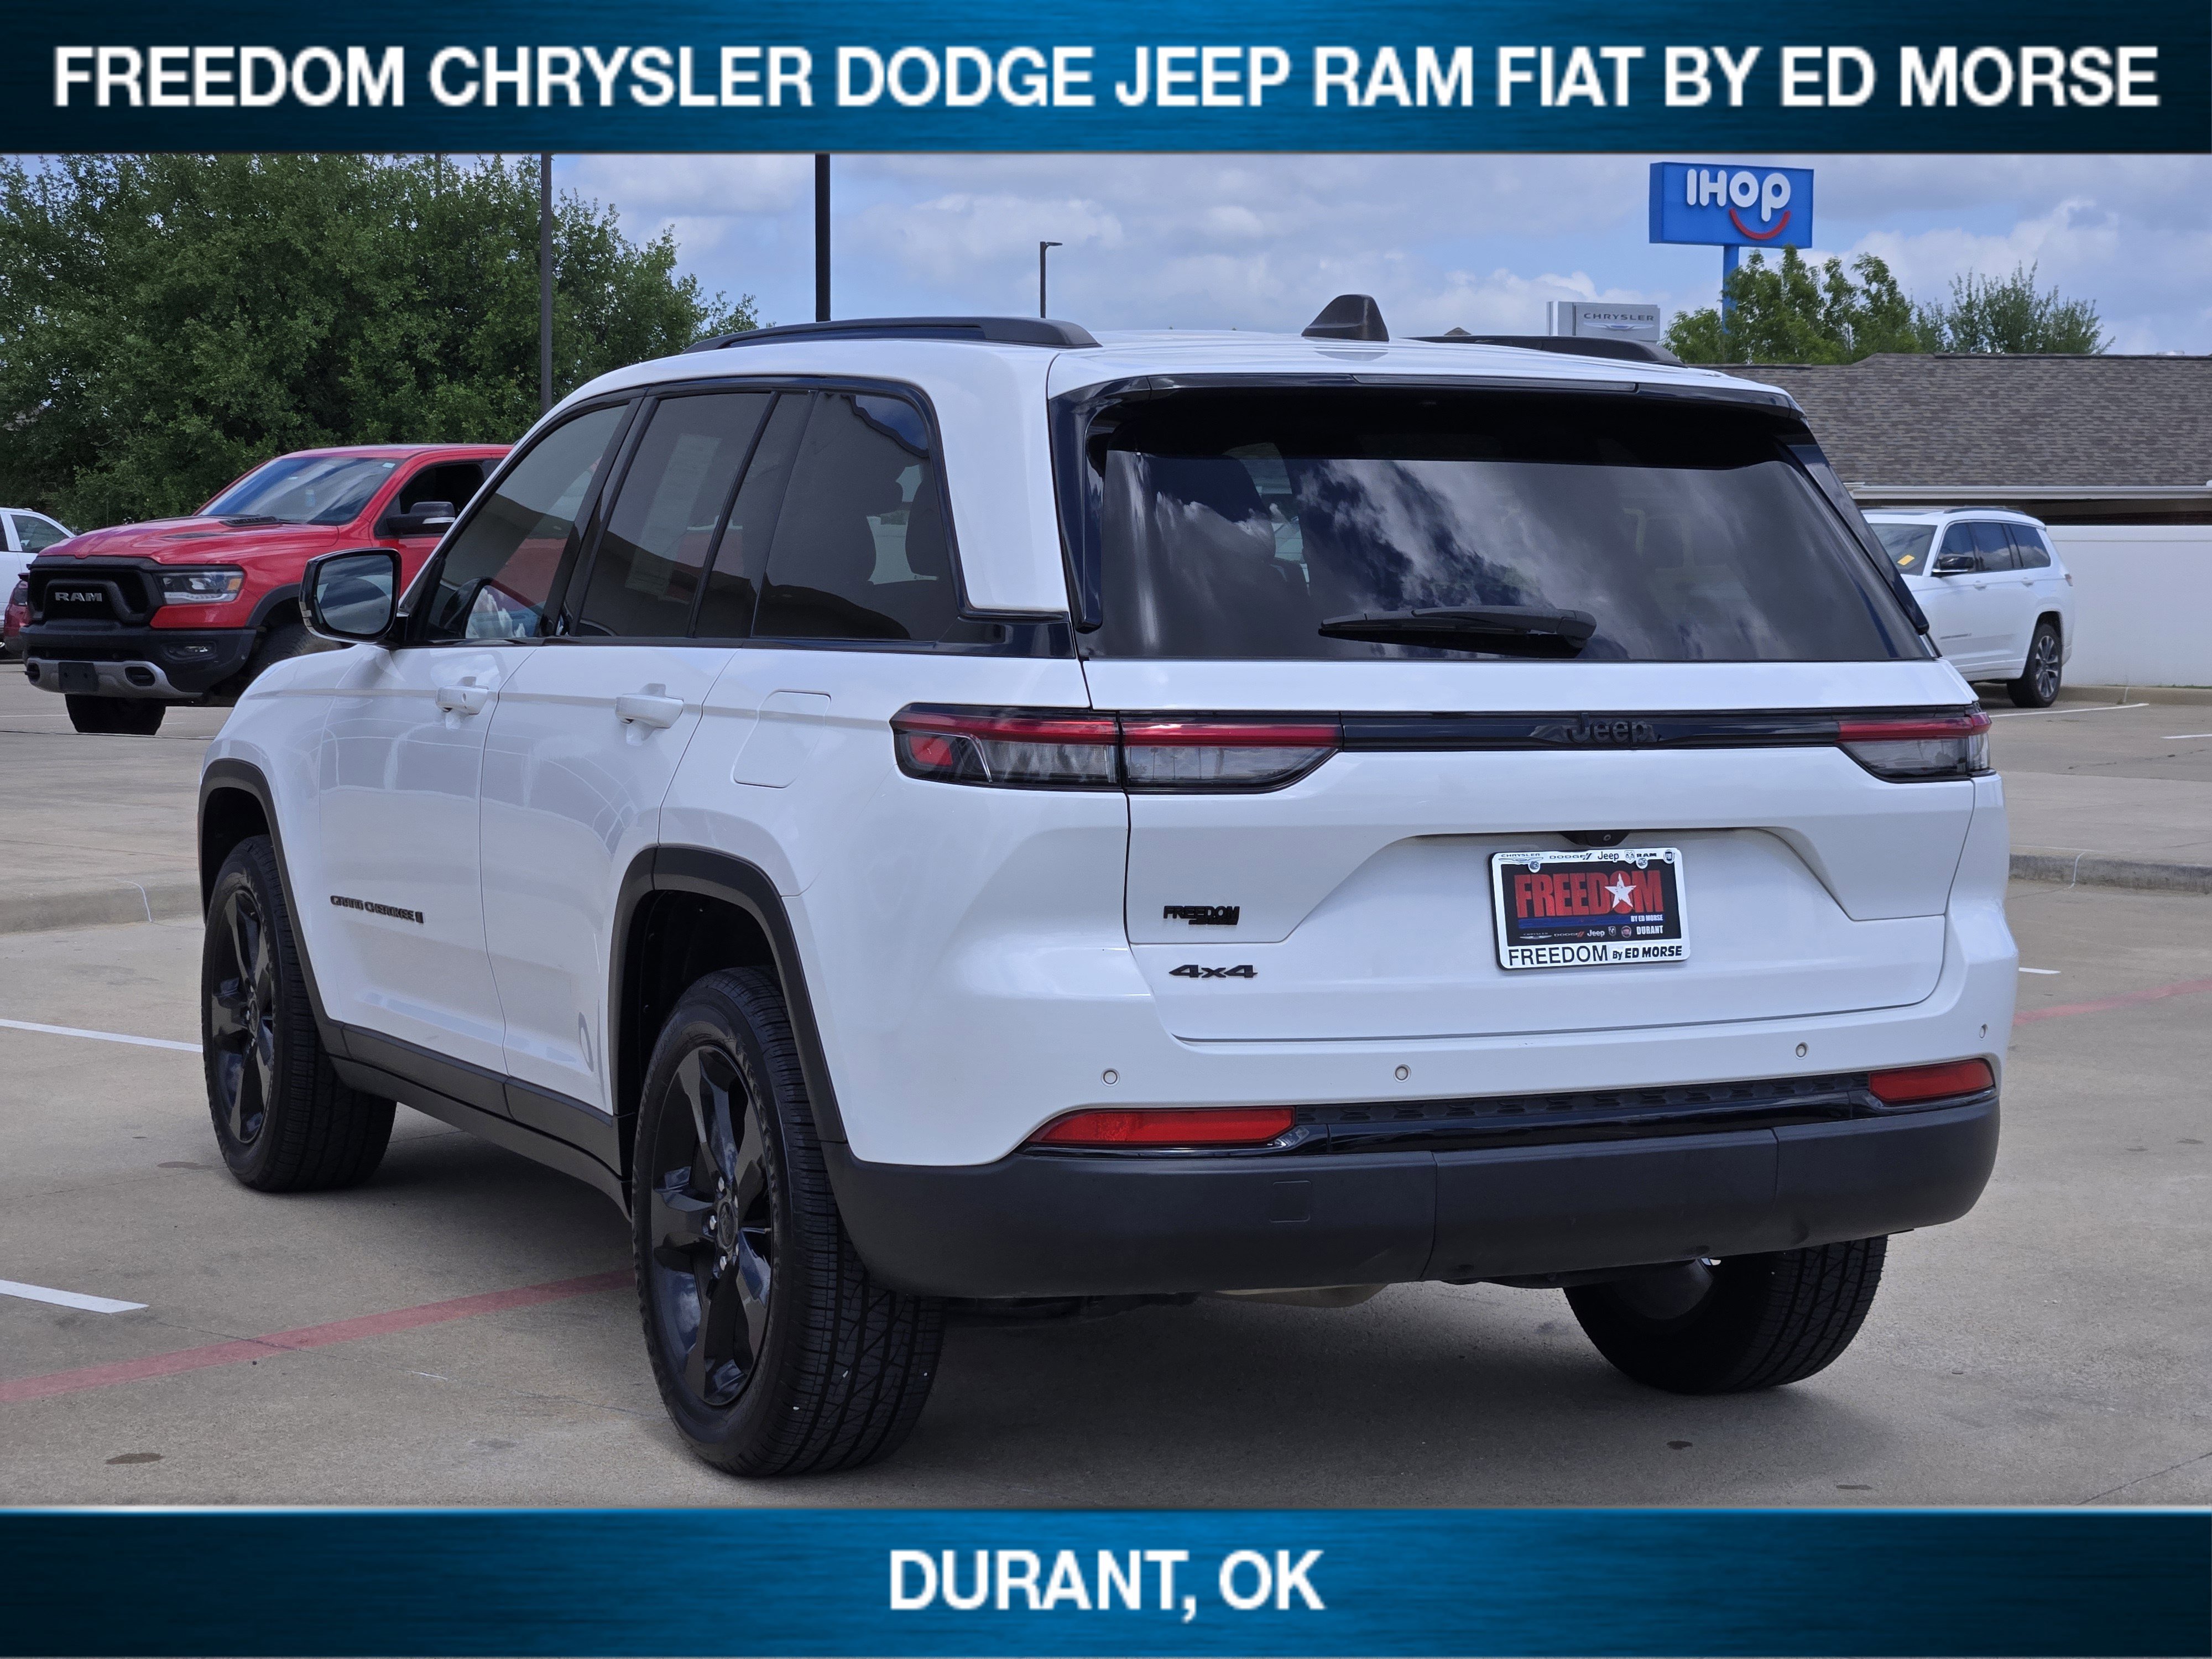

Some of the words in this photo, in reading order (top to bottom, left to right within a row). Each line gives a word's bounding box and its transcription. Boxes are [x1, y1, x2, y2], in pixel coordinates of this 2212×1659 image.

[1687, 168, 1791, 222] IHOP
[1583, 312, 1654, 322] CHRYSLER
[55, 592, 103, 602] RAM
[1567, 712, 1648, 744] Jeep
[1597, 851, 1620, 862] Jeep
[1514, 870, 1664, 919] FREEDOM
[1163, 905, 1240, 919] FREEDOM
[1587, 929, 1605, 938] Jeep
[1636, 925, 1663, 935] DURANT
[1508, 945, 1608, 966] FREEDOM
[1625, 947, 1639, 958] ED
[1641, 945, 1682, 958] MORSE
[1168, 964, 1258, 978] 4x4
